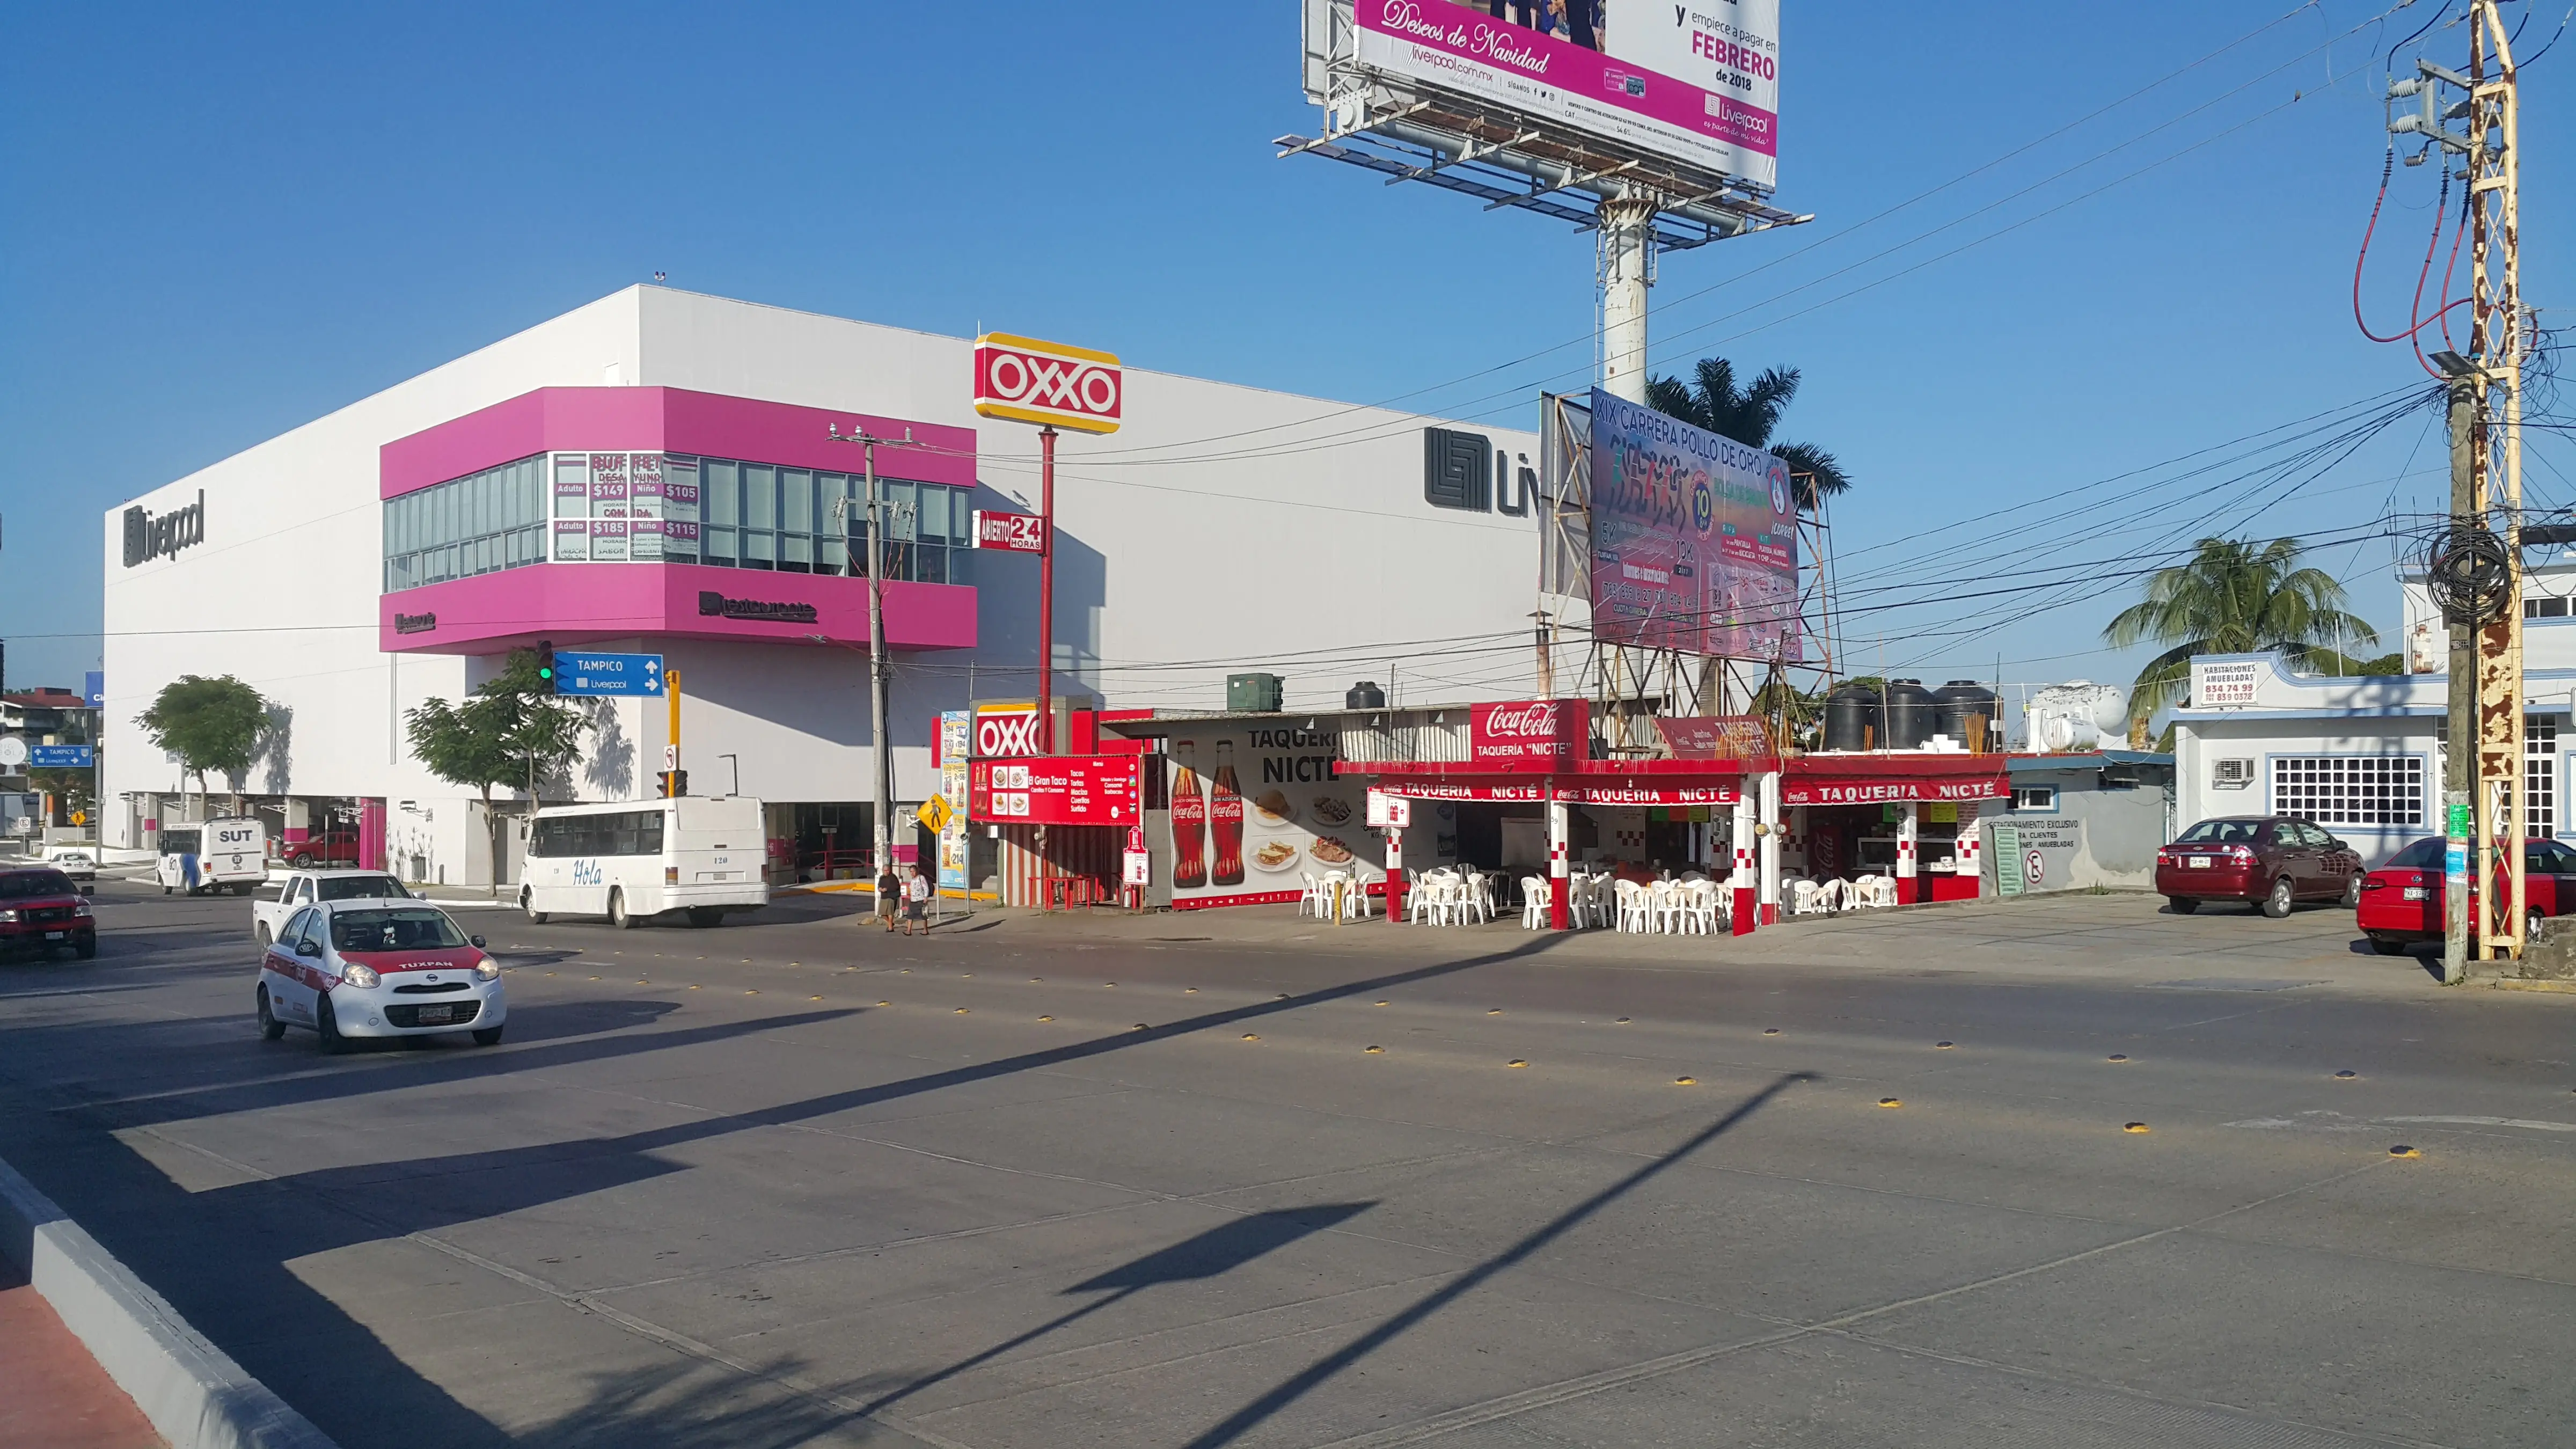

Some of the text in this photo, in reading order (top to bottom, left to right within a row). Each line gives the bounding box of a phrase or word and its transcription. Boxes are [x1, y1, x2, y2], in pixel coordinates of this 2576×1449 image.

[1675, 4, 1776, 53] y empiece a pagar en
[1381, 0, 1551, 74] Deseos de Navidad
[1692, 30, 1775, 81] FEBRERO
[1507, 80, 1530, 94] SÍGANOS
[1716, 69, 1752, 91] de 2018
[1564, 109, 1576, 120] CAT
[1721, 103, 1768, 134] Liverpool
[1711, 122, 1730, 134] parte
[991, 354, 1116, 413] OXXO
[1596, 393, 1617, 427] XIX
[1620, 404, 1679, 448] CARRERA
[1681, 427, 1718, 462] POLLO
[1721, 442, 1736, 469] DE
[1738, 449, 1762, 477] ORO
[558, 484, 696, 498] Adulto $149 Niño $105
[1696, 489, 1709, 518] 10
[558, 521, 696, 535] Adulto $185 Niño $115
[981, 519, 1010, 543] ABIERTO
[1011, 517, 1040, 540] 24
[1601, 521, 1617, 545] 5K
[1011, 540, 1041, 548] HORAS
[1675, 538, 1694, 562] 10K
[577, 660, 623, 671] TAMPICO
[2204, 664, 2256, 674] HABITACIONES
[590, 679, 627, 690] Liverpool
[2206, 674, 2254, 683] AMUEBLADAS
[2205, 684, 2253, 693] 834 74 99
[2234, 693, 2252, 701] 0378
[1485, 702, 1561, 737] Coca-Cola
[1248, 729, 1337, 750] TAQUERI
[1476, 744, 1524, 757] TAQUERÍA
[1028, 775, 1067, 786] El Gran Taco
[1384, 784, 1402, 793] Coca-Cola
[1404, 782, 1472, 797] TAQUERIA
[1491, 783, 1537, 799] NICTÉ
[1557, 785, 1730, 802] Coca-Cola TAQUERIA NICTÉ
[1788, 780, 1995, 802] Coca-Cola TAQUERIA NICTÉ
[1070, 796, 1090, 804] Cueritos
[1173, 804, 1203, 819] Coca-Cola
[1212, 803, 1241, 818] Coca-Cola
[1550, 816, 1558, 824] 59
[2047, 820, 2079, 829] EXCLUSIVO
[219, 830, 253, 843] SUT
[573, 859, 602, 886] Hola
[398, 961, 453, 969] TUXPAN
